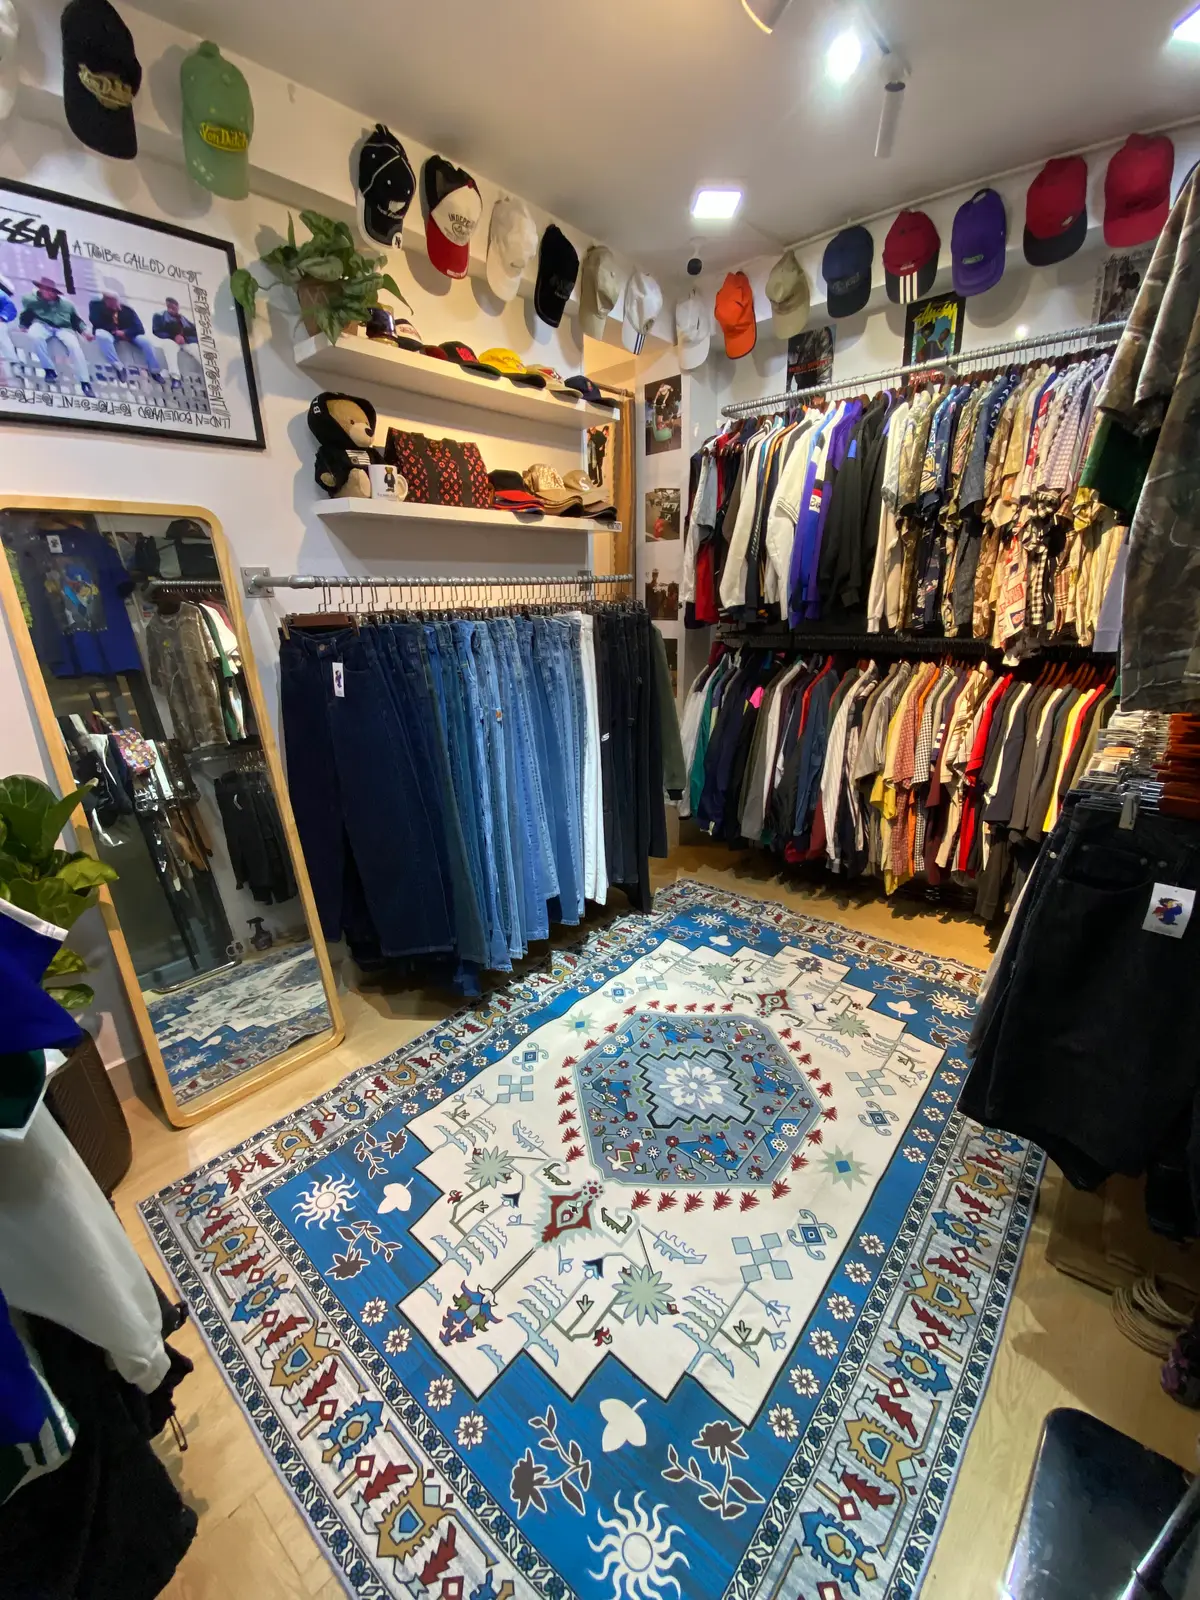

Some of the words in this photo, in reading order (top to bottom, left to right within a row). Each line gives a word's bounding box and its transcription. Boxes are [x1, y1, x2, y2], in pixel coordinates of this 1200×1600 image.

[72, 239, 82, 256] A
[83, 242, 121, 262] TRIBE
[123, 252, 166, 274] CALLED
[167, 265, 202, 285] QUEST
[57, 395, 132, 417] REPRESENT
[138, 406, 192, 425] BOULEVARD
[195, 413, 231, 429] LINDEN
